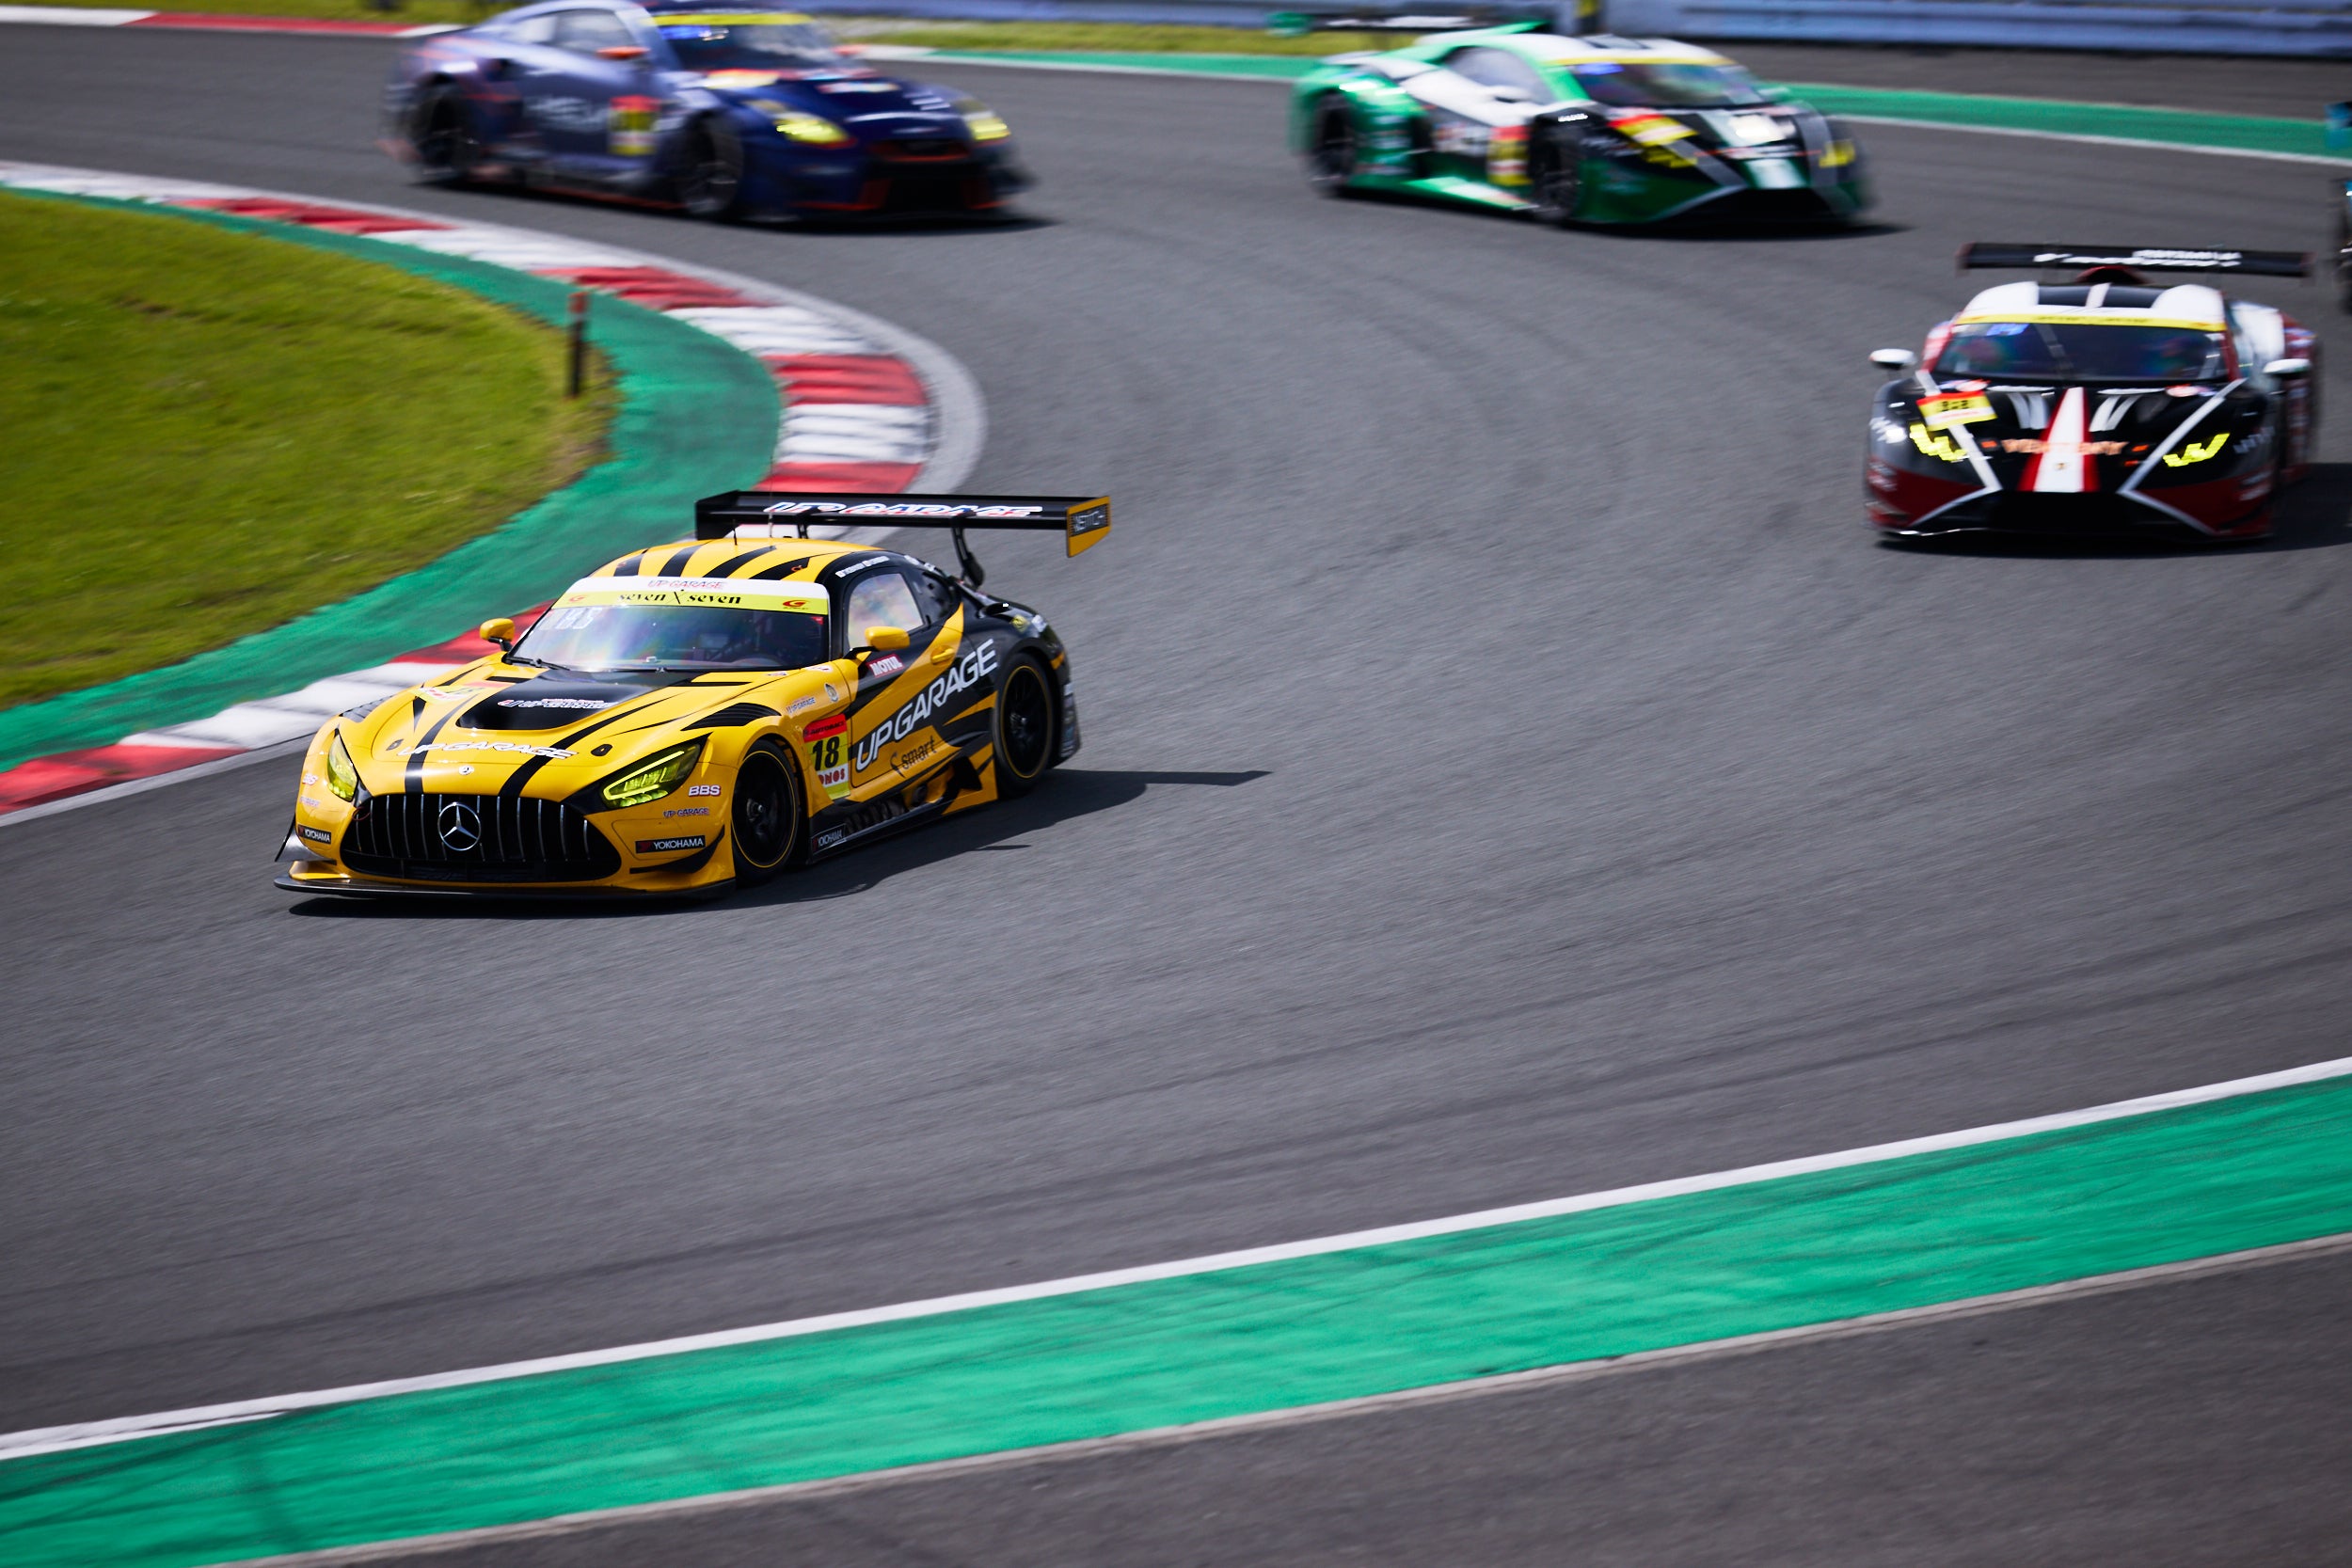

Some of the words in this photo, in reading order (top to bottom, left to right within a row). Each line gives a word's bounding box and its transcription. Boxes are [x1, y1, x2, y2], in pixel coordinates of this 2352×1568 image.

[647, 579, 668, 588] UP
[669, 580, 727, 590] GARAGE
[618, 593, 666, 602] seven
[688, 594, 741, 604] seven
[869, 656, 903, 676] MOTUL
[855, 720, 893, 771] UP
[895, 639, 998, 741] GARAGE
[442, 740, 579, 760] GARAGE
[812, 736, 840, 771] 18
[688, 784, 721, 798] BBS
[662, 810, 675, 818] UP
[677, 807, 710, 816] GARAGE
[653, 837, 704, 850] YOKOHAMA
